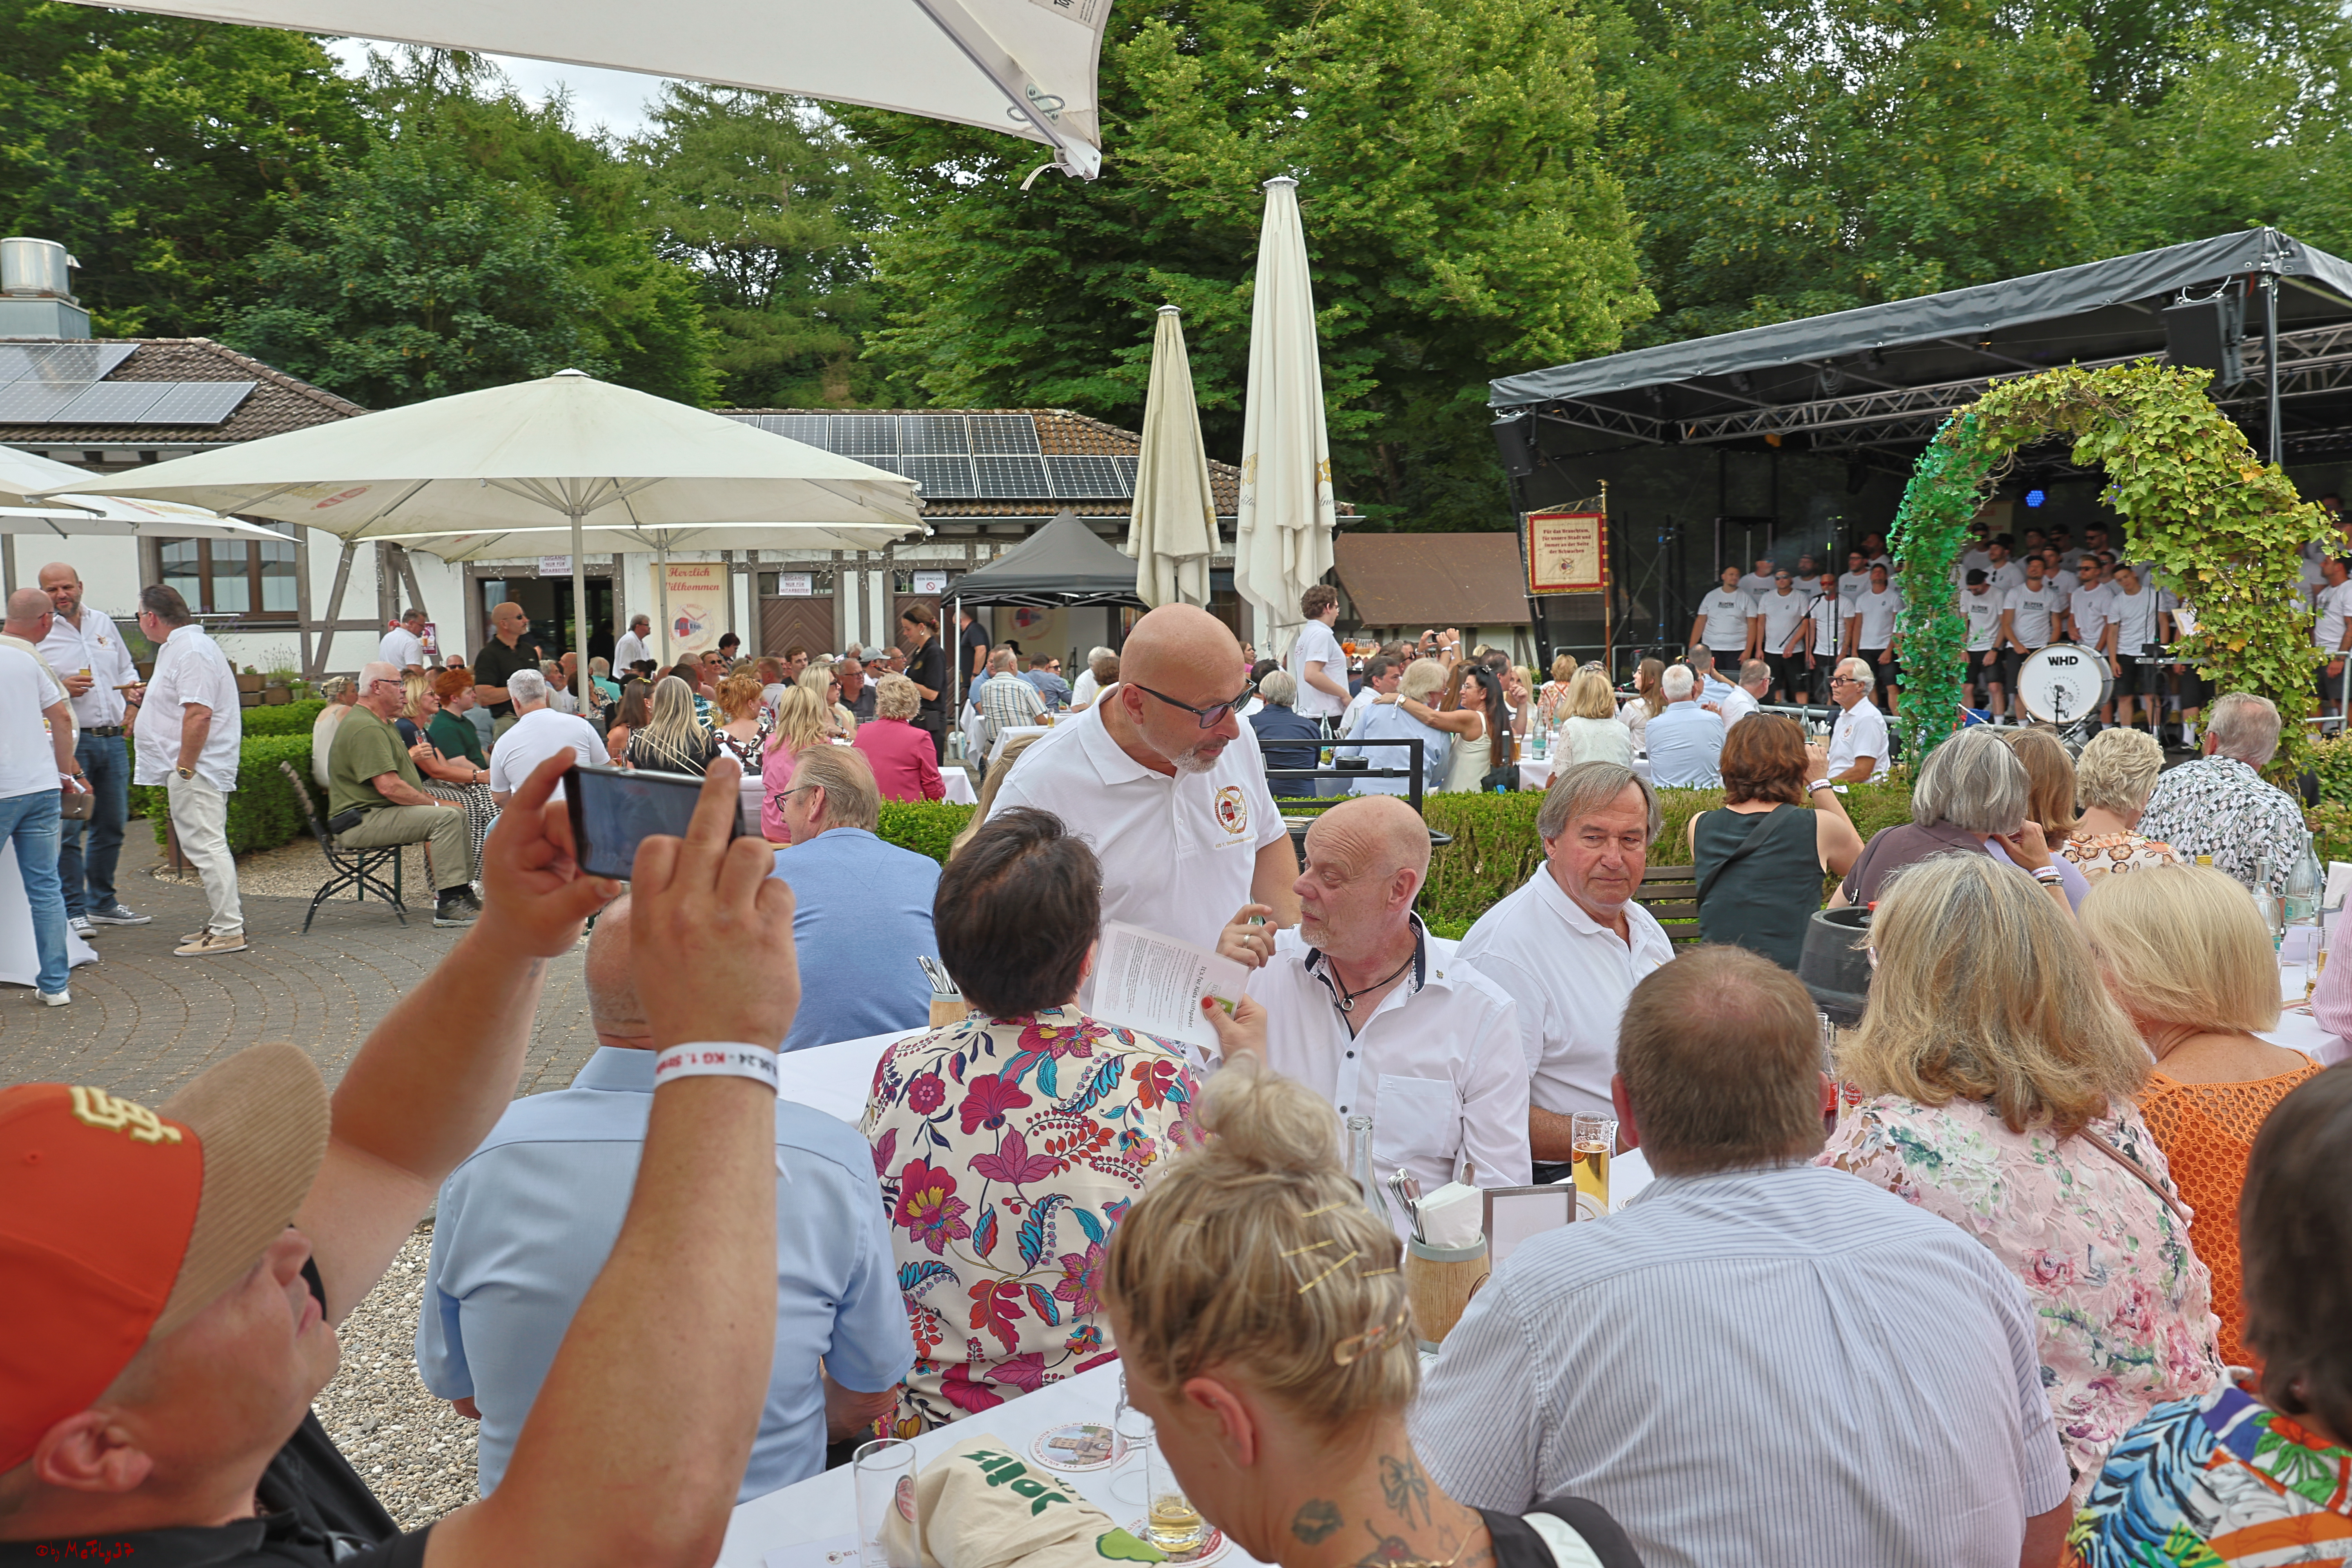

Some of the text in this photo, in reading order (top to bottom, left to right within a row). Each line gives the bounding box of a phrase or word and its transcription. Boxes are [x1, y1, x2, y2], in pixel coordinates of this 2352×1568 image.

[668, 567, 710, 577] Herzlich
[2047, 656, 2079, 666] WHD
[1188, 999, 1196, 1028] Hilfspaket
[703, 1053, 725, 1064] KG
[1034, 1431, 1051, 1454] MITTELALTER
[1044, 1457, 1060, 1466] KÖLN
